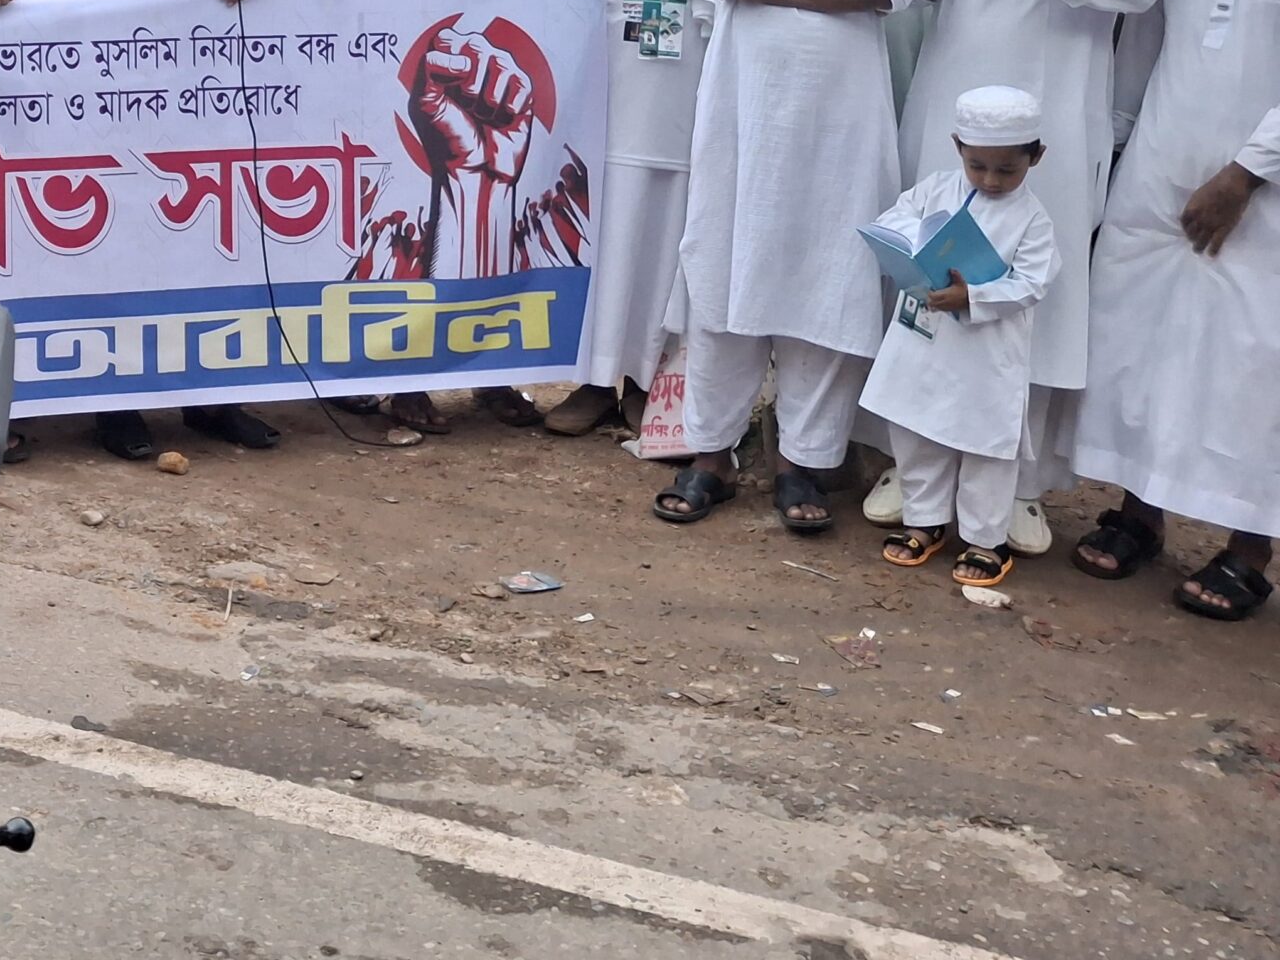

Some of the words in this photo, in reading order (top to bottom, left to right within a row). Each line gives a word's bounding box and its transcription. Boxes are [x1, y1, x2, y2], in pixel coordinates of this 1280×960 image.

[91, 27, 181, 80] মুসলিম
[189, 23, 287, 68] নির্যাতন
[295, 34, 338, 65] বন্ধ
[348, 32, 401, 64] এবং
[64, 94, 85, 120] ও
[95, 89, 169, 122] মাদক
[178, 75, 302, 120] প্রতিরোধে
[144, 132, 378, 254] সভা
[13, 281, 557, 383] আবাবিল
